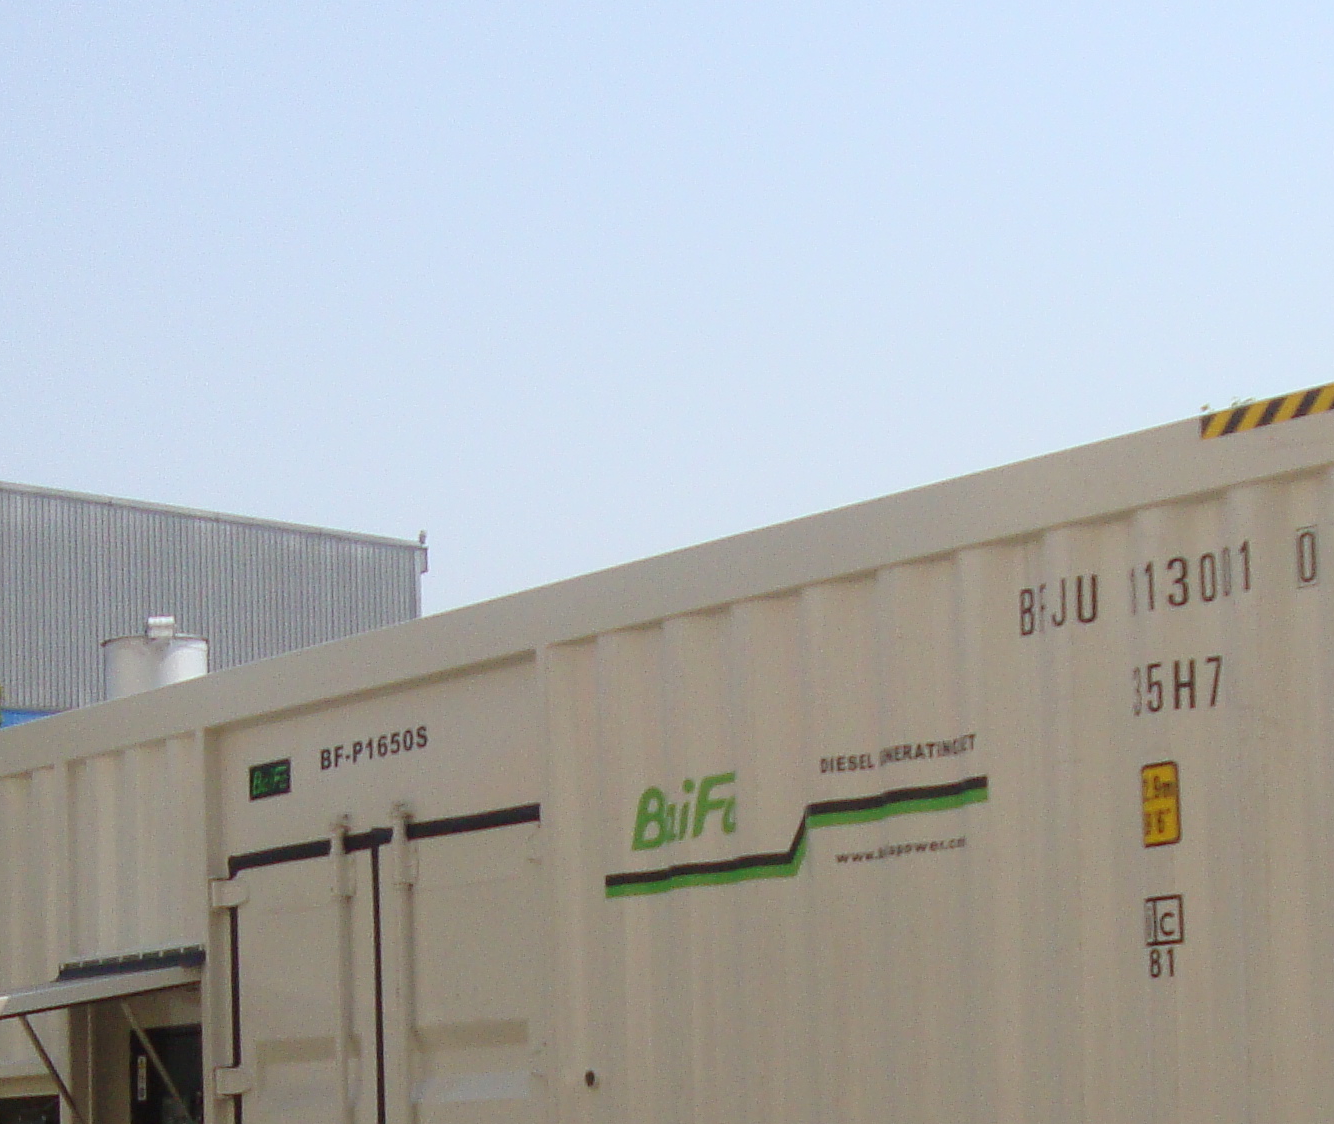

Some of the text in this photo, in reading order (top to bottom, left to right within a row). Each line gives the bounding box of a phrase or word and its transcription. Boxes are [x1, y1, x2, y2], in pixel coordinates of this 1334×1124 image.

[1298, 531, 1317, 583] 0
[320, 725, 428, 771] BF-P1650S
[820, 753, 874, 774] DIESEL
